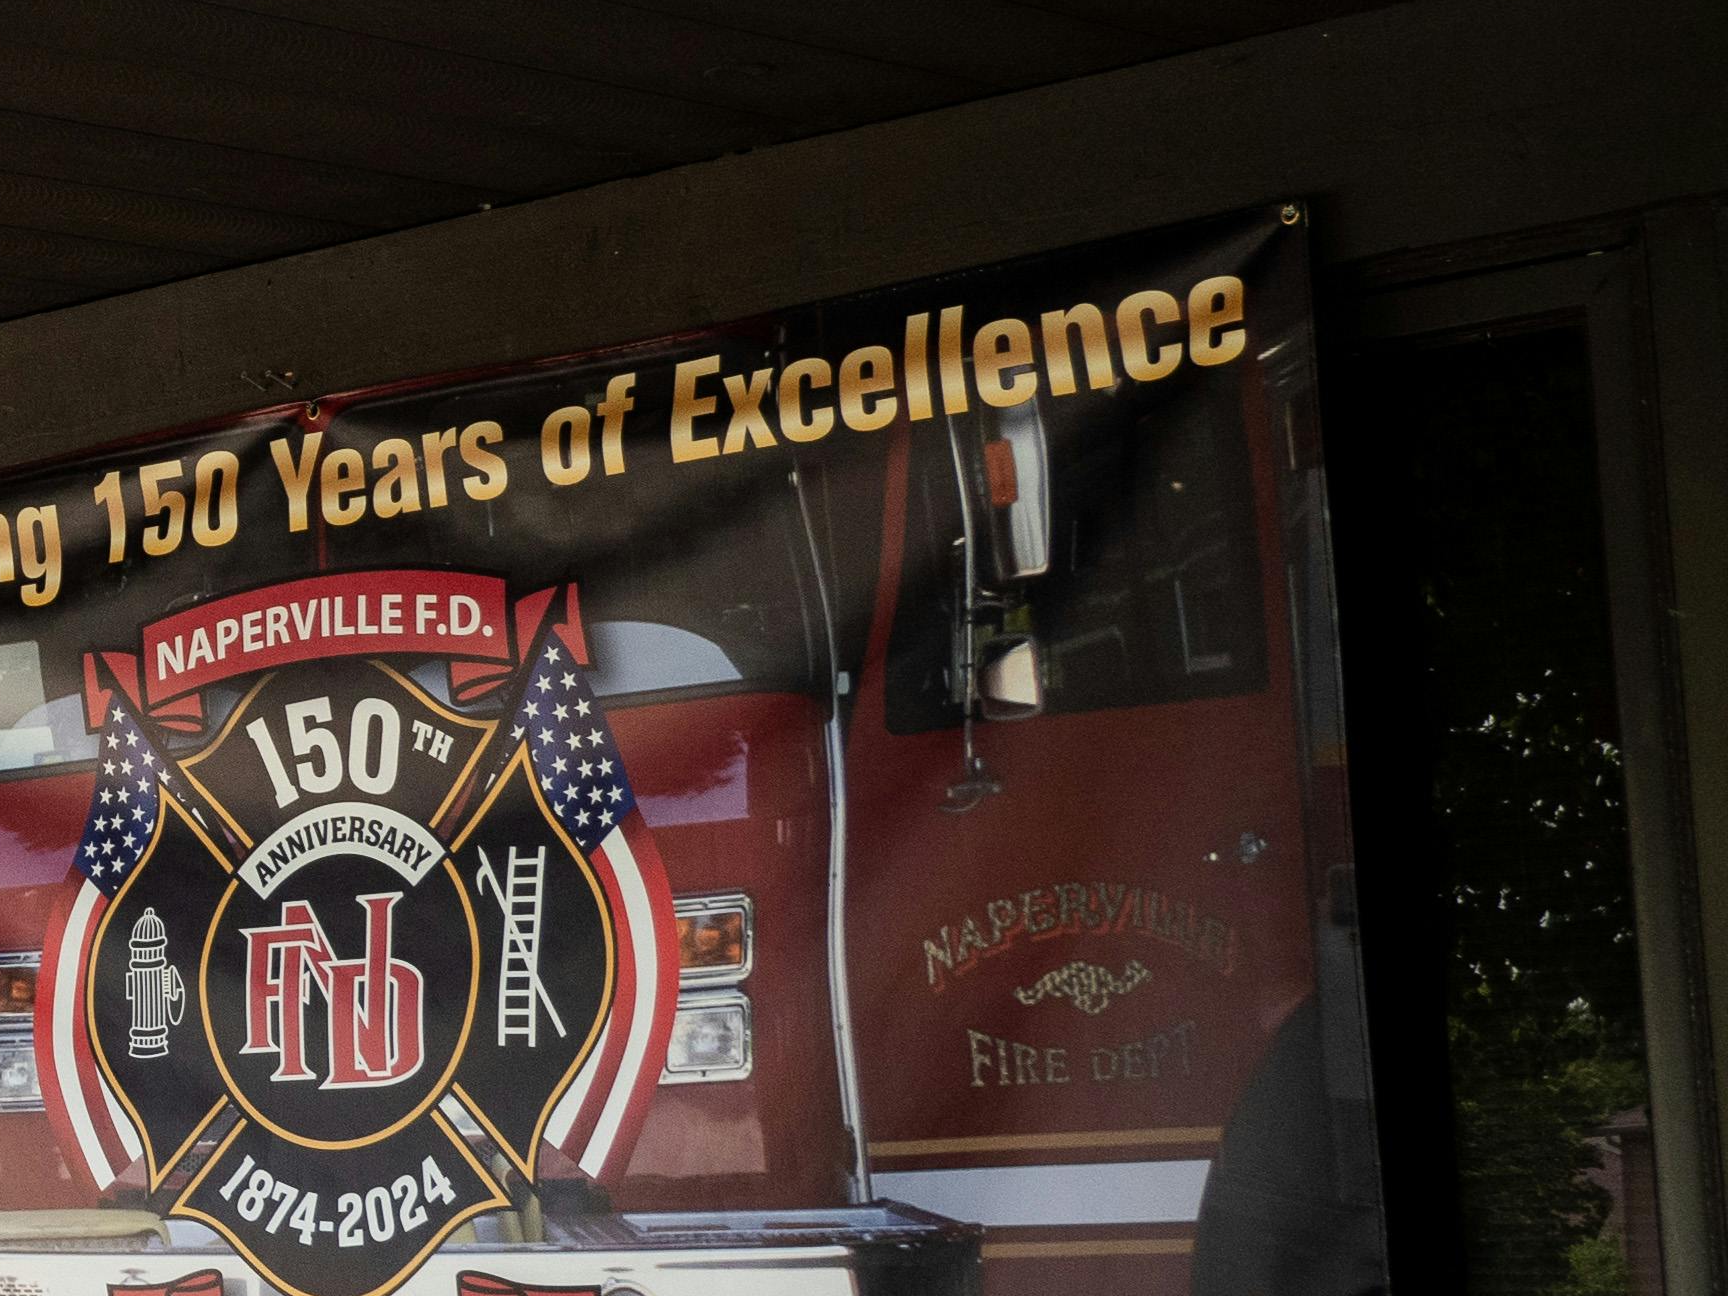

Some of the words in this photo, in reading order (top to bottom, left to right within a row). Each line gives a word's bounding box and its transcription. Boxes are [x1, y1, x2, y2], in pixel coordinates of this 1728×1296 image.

[94, 450, 239, 564] 150
[270, 419, 508, 533] Years
[541, 372, 637, 488] of
[669, 274, 1247, 466] Excellence
[156, 594, 403, 680] NAPERVILLE
[415, 594, 494, 637] F.D.
[254, 815, 432, 888] ANNIVERSARY
[967, 1028, 1071, 1088] FIRE
[219, 1154, 457, 1247] 1874-2024
